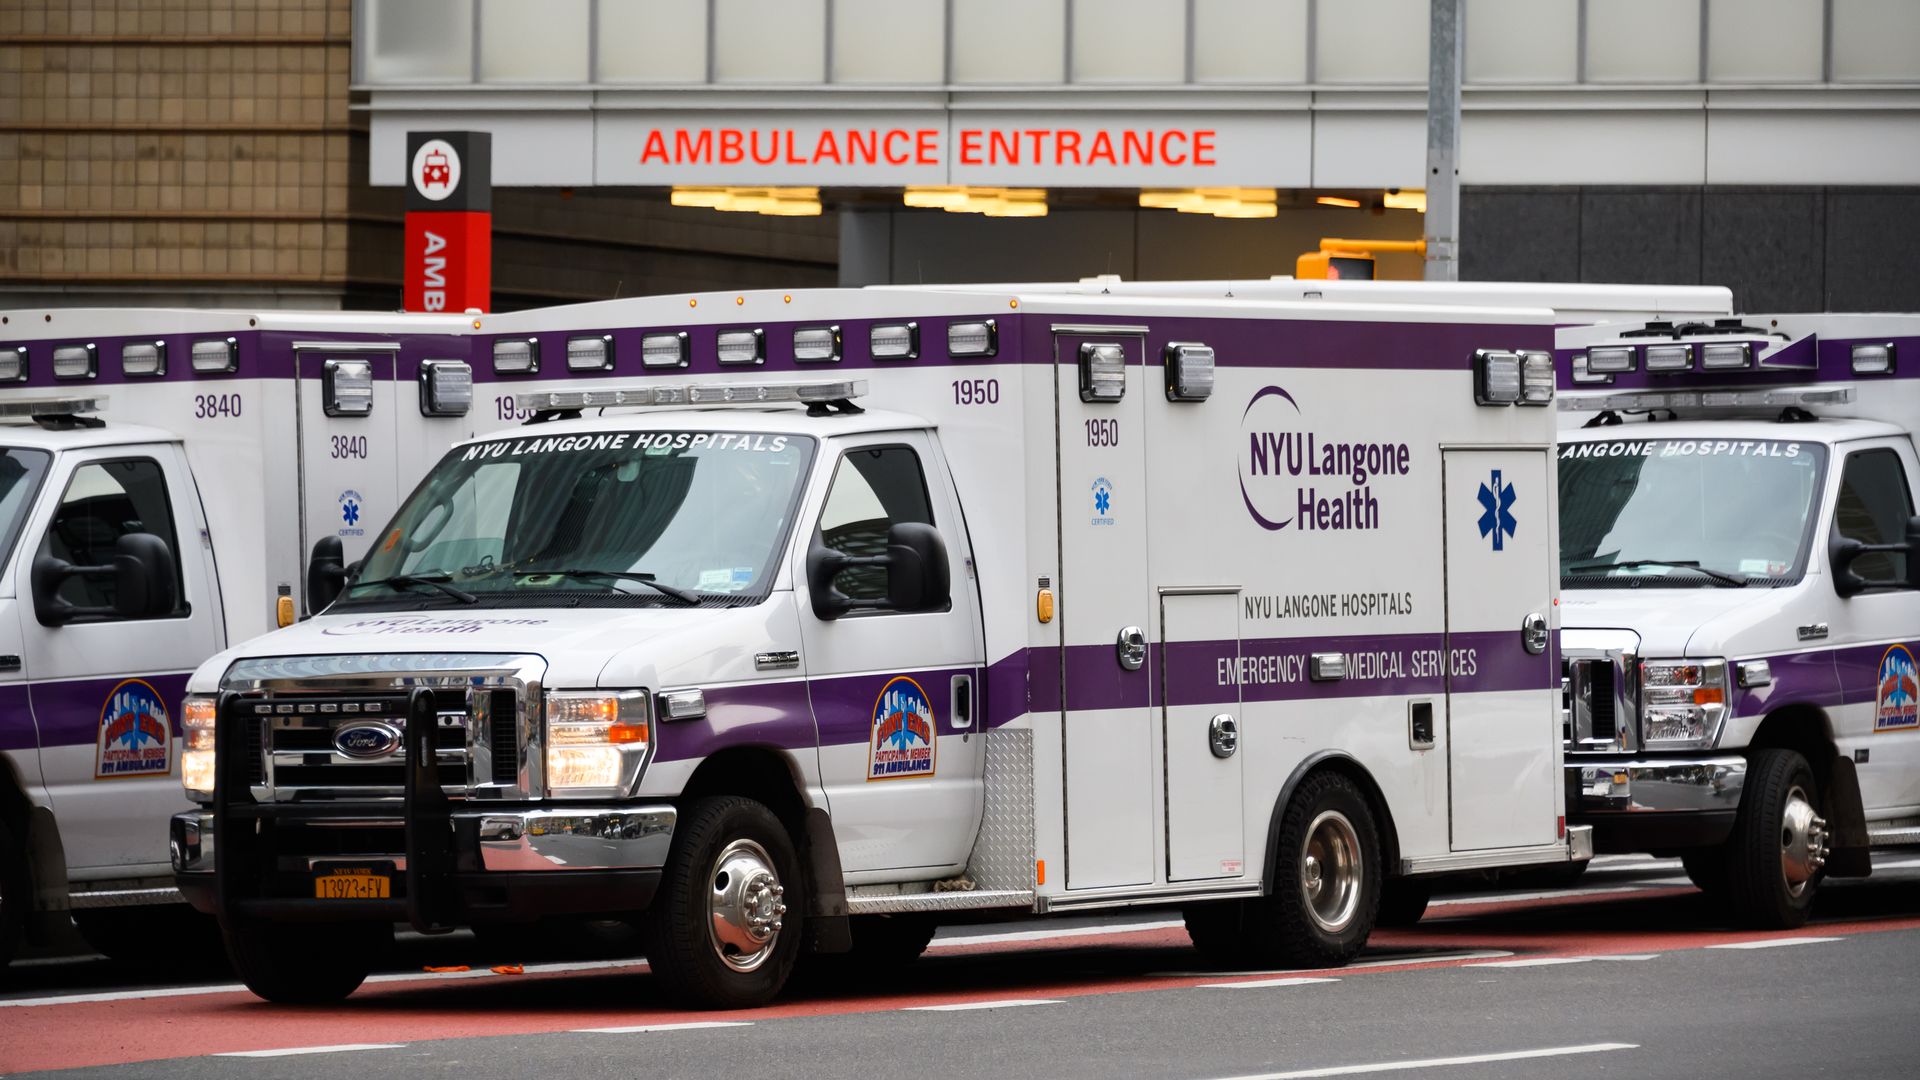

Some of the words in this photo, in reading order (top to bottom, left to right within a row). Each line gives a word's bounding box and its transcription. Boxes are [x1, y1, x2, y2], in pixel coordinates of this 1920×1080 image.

[641, 128, 940, 166] AMBULANCE
[959, 128, 1217, 166] ENTRANCE
[424, 231, 446, 311] AMB
[952, 379, 999, 405] 1950
[195, 394, 242, 418] 3840
[495, 396, 538, 420] 19
[1085, 419, 1119, 447] 1950
[331, 435, 367, 459] 3840
[462, 443, 512, 461] NYU
[511, 434, 629, 455] LANGONE
[634, 433, 788, 453] HOSPITALS
[1250, 432, 1302, 476] NYU
[1308, 432, 1410, 486] Langone
[1557, 442, 1656, 460] ANGONE
[1660, 441, 1800, 458] HOSPITALS
[1298, 486, 1379, 530] Health
[1245, 596, 1272, 619] NYU
[1276, 594, 1337, 619] LANGONE
[1342, 592, 1413, 616] HOSPITALS
[1217, 654, 1305, 686] EMERGENCY
[1345, 651, 1406, 680] MEDICAL
[1411, 649, 1477, 678] SERVCES
[347, 731, 377, 747] Ford
[116, 760, 165, 771] AMBULANCE
[873, 762, 885, 775] 911
[886, 760, 931, 773] AMBULANCE
